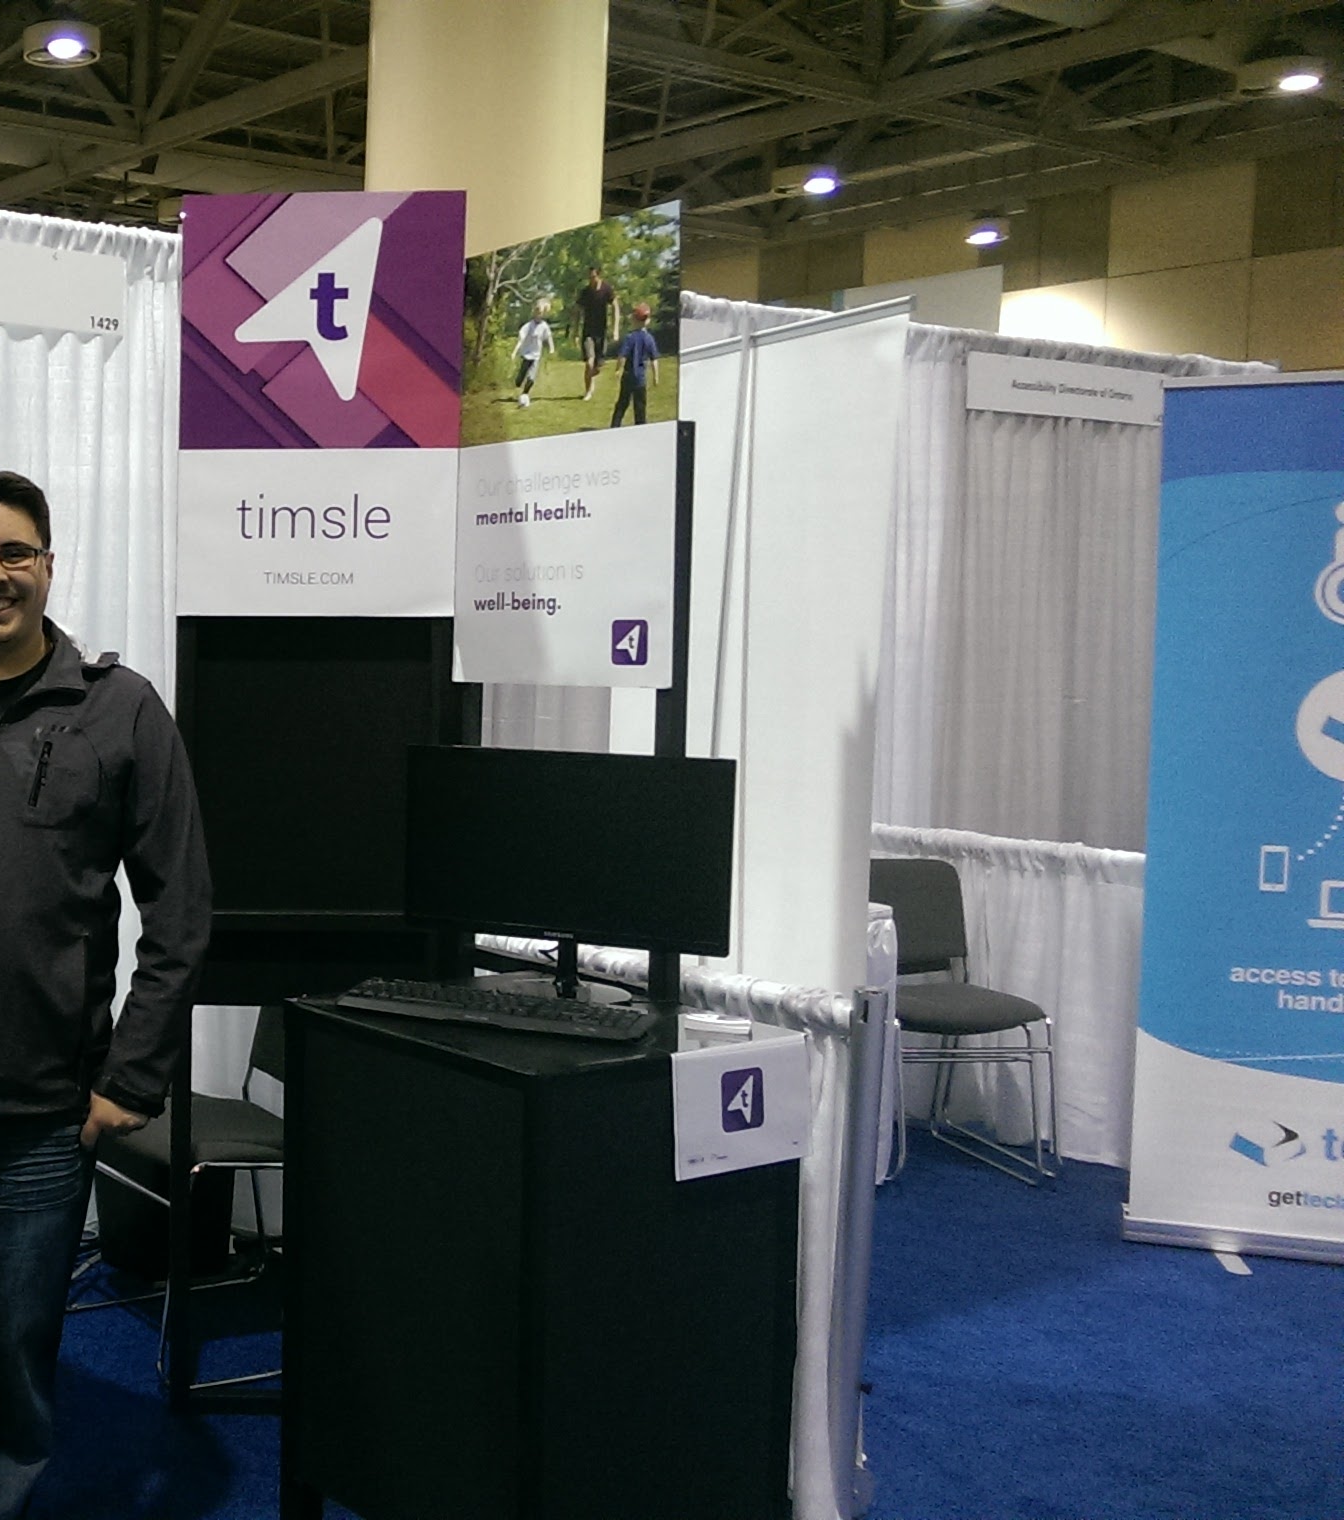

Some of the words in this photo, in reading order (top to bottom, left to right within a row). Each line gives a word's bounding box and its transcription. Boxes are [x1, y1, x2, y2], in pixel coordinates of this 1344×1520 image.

[309, 272, 349, 341] t
[90, 315, 120, 331] 1429
[477, 478, 500, 497] Our
[503, 472, 581, 495] challenge
[586, 469, 621, 486] was
[236, 493, 391, 539] timsle
[476, 503, 528, 526] mental
[533, 499, 591, 522] health.
[263, 572, 354, 585] TIMSLE.COM
[475, 563, 500, 583] Our
[504, 562, 566, 582] solution
[570, 563, 584, 580] is
[474, 591, 561, 616] well-being.
[1229, 967, 1321, 986] access
[1277, 989, 1344, 1013] hand
[1321, 1128, 1344, 1161] t
